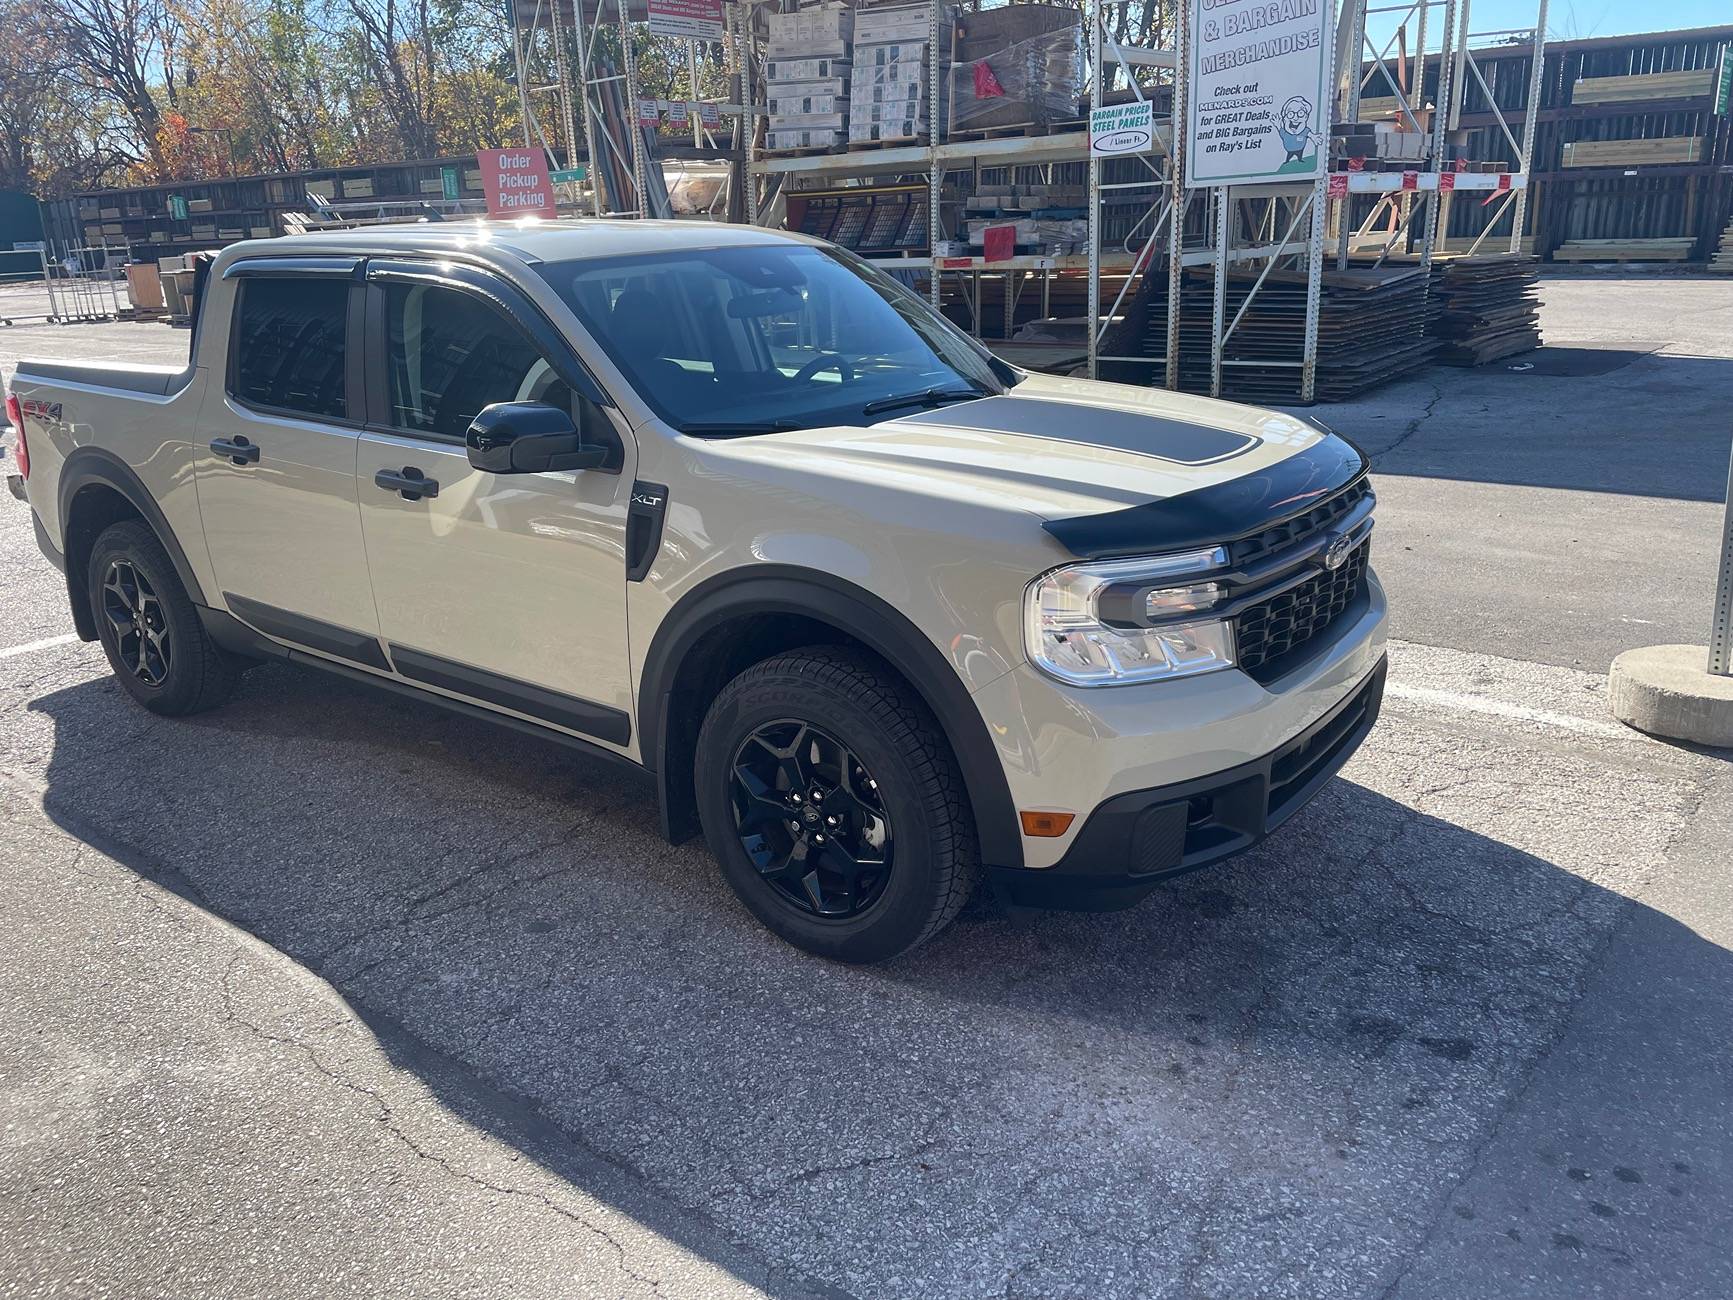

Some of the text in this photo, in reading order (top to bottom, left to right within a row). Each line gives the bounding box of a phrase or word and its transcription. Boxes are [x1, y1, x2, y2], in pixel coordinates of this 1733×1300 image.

[1204, 0, 1317, 42] & BARGAIN
[1201, 28, 1320, 75] MERCHANDISE
[1214, 82, 1258, 97] Check out
[1198, 95, 1273, 112] MENARDS.COM
[1092, 104, 1150, 121] BARGAIN PRICED
[1200, 109, 1271, 126] for GREAT Deals
[1092, 115, 1150, 133] STEEL PANELS
[1197, 124, 1273, 140] and BIG Bargains
[1205, 138, 1262, 154] on Ray's List
[498, 153, 531, 169] Order
[498, 172, 538, 189] Pickup
[499, 191, 545, 208] Parking
[631, 493, 662, 506] XLT
